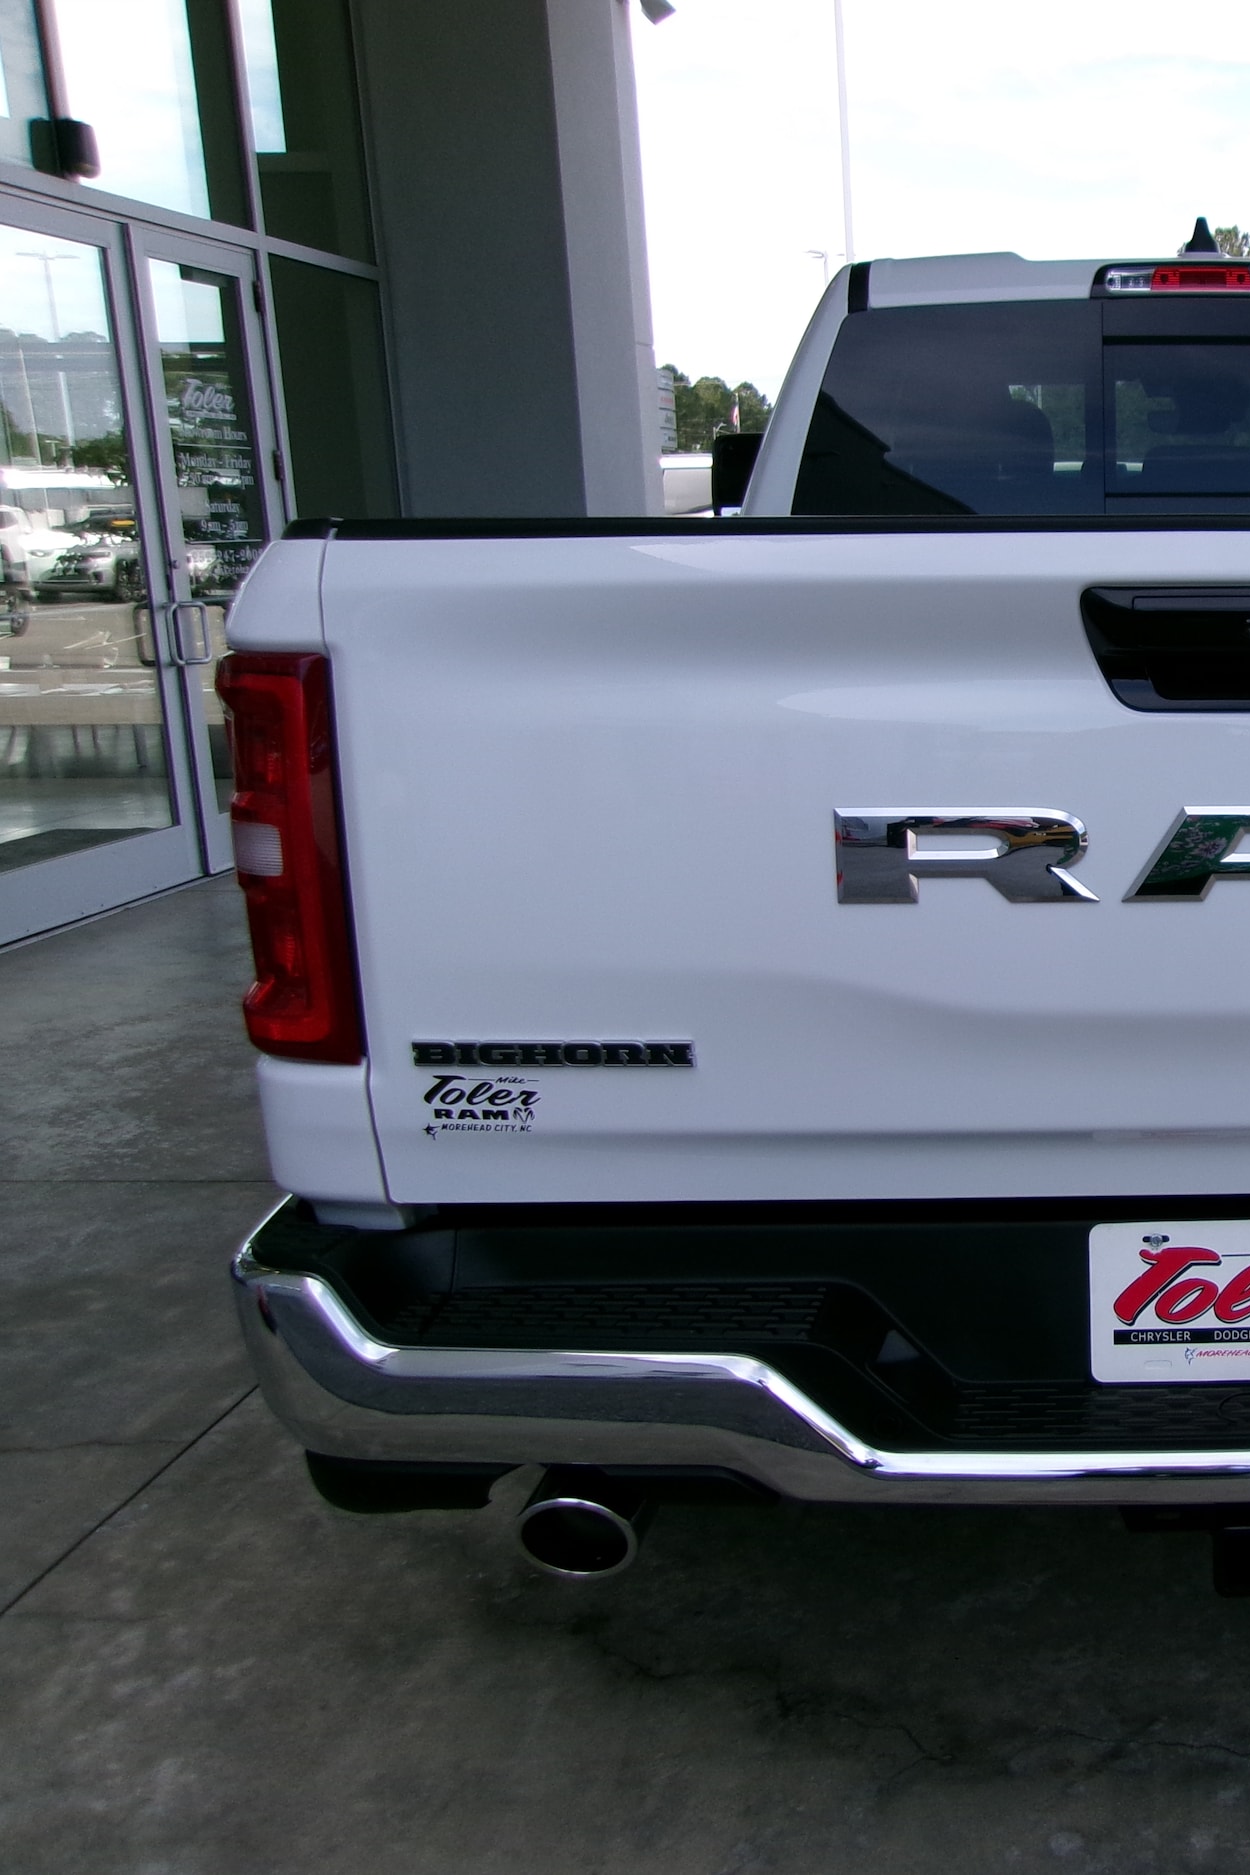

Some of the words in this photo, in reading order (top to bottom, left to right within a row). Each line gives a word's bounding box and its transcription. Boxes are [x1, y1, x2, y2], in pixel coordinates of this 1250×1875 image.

[183, 378, 235, 410] Toler
[222, 426, 248, 441] Hours
[179, 452, 217, 470] Monday
[224, 454, 252, 473] Friday
[204, 499, 241, 517] Saturday
[411, 1039, 697, 1068] BIGHORN
[495, 1076, 527, 1085] Mike
[423, 1075, 542, 1107] Toler
[434, 1108, 510, 1121] RAM
[441, 1123, 492, 1132] MOREHEAD
[494, 1124, 518, 1133] CITY,
[519, 1124, 533, 1133] NC
[1130, 1331, 1191, 1342] CHRYSLER
